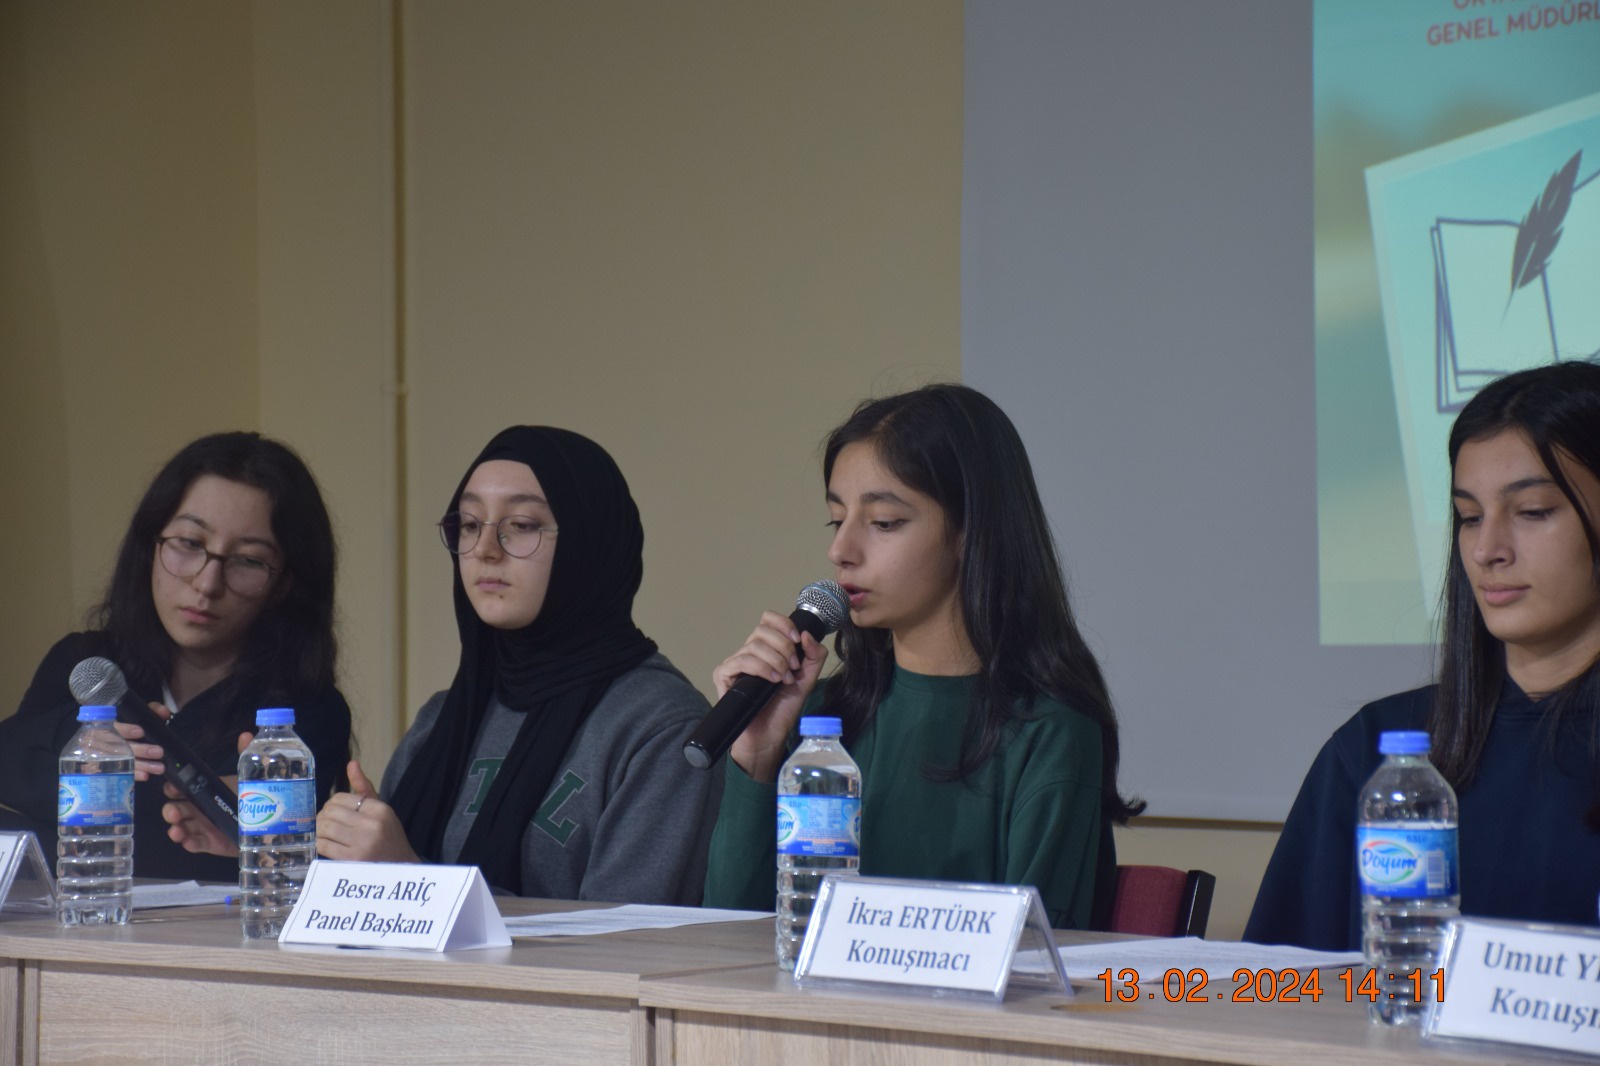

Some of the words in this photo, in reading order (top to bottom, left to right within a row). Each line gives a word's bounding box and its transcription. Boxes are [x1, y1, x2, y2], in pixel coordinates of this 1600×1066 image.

[1426, 16, 1500, 46] GENEL
[239, 799, 277, 818] Doyum
[1362, 848, 1417, 875] Doyum
[332, 878, 384, 900] Besra
[387, 877, 436, 906] ARİÇ
[304, 909, 360, 931] Panel
[359, 912, 434, 937] Başkanı
[847, 896, 893, 927] İkra
[898, 903, 996, 934] ERTÜRK
[847, 939, 971, 973] Konuşmacı
[1484, 941, 1568, 978] Umut
